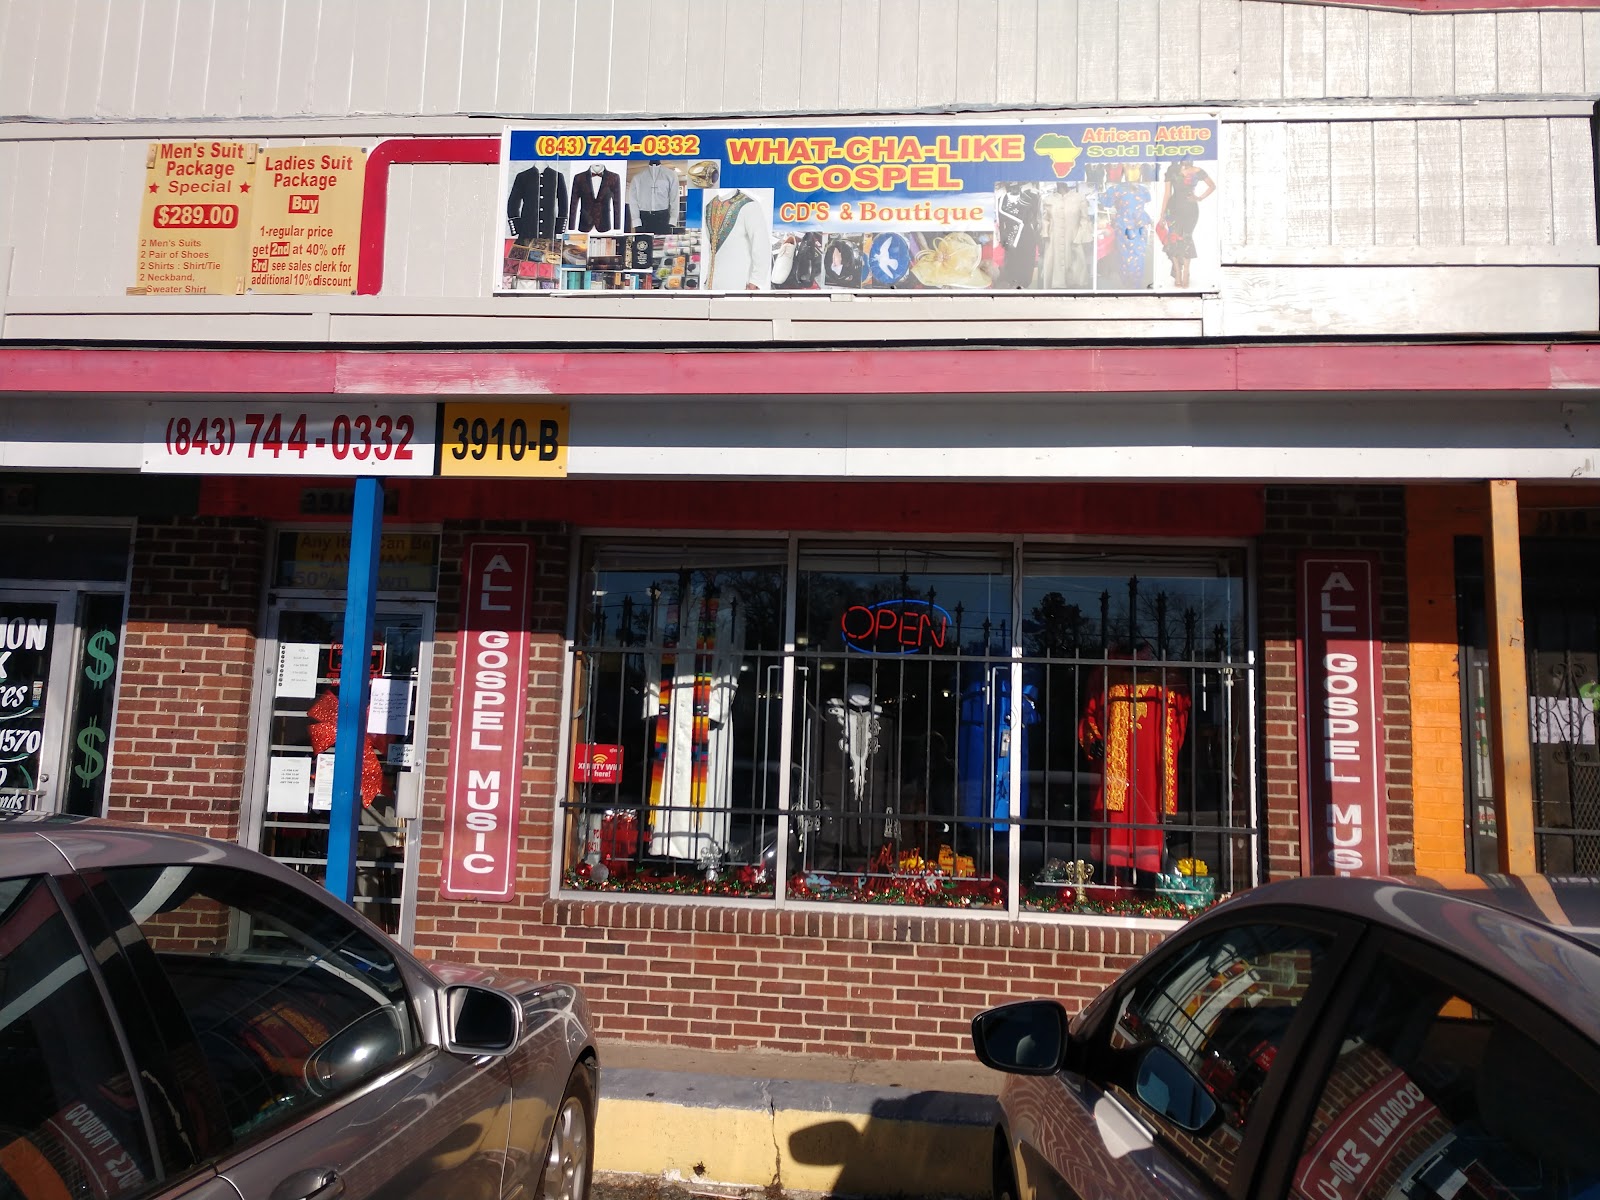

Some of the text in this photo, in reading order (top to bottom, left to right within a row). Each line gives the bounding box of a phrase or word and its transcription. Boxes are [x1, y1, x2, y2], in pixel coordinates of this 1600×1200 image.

[1082, 125, 1211, 143] African Attire
[160, 142, 244, 160] Men's Suit
[535, 134, 700, 156] (843) 744-0332
[726, 134, 1025, 165] WHAT-CHA-LIKE
[1087, 144, 1205, 157] Sold Here
[166, 160, 235, 179] Package
[265, 155, 353, 171] Ladies Suit
[273, 172, 337, 191] Package
[788, 164, 963, 192] GOSPEL
[168, 180, 231, 197] Special
[292, 196, 318, 213] Buy
[780, 201, 984, 225] CD'S & Boutique
[157, 206, 234, 226] $289.00
[260, 225, 333, 239] 1-regular price
[141, 239, 201, 247] 2 Men's Suits
[252, 243, 346, 257] get 2nd at 40% off
[140, 250, 209, 259] 2 Pair of Shoes
[140, 262, 146, 270] 2
[148, 261, 175, 270] Shirts
[183, 261, 221, 270] Shirt/Tie
[252, 260, 352, 272] 3rd see sales clerk for
[139, 273, 195, 282] 2 Neckband,
[251, 274, 352, 287] additional 10% discount
[146, 285, 207, 293] Sweater Shirt
[165, 413, 415, 461] (843) 744-0332
[451, 417, 559, 462] 3910-B
[841, 605, 947, 648] OPEN
[463, 554, 513, 874] ALL GOSPEL MUSIC
[1320, 571, 1363, 877] ALL GOSPEL MUS
